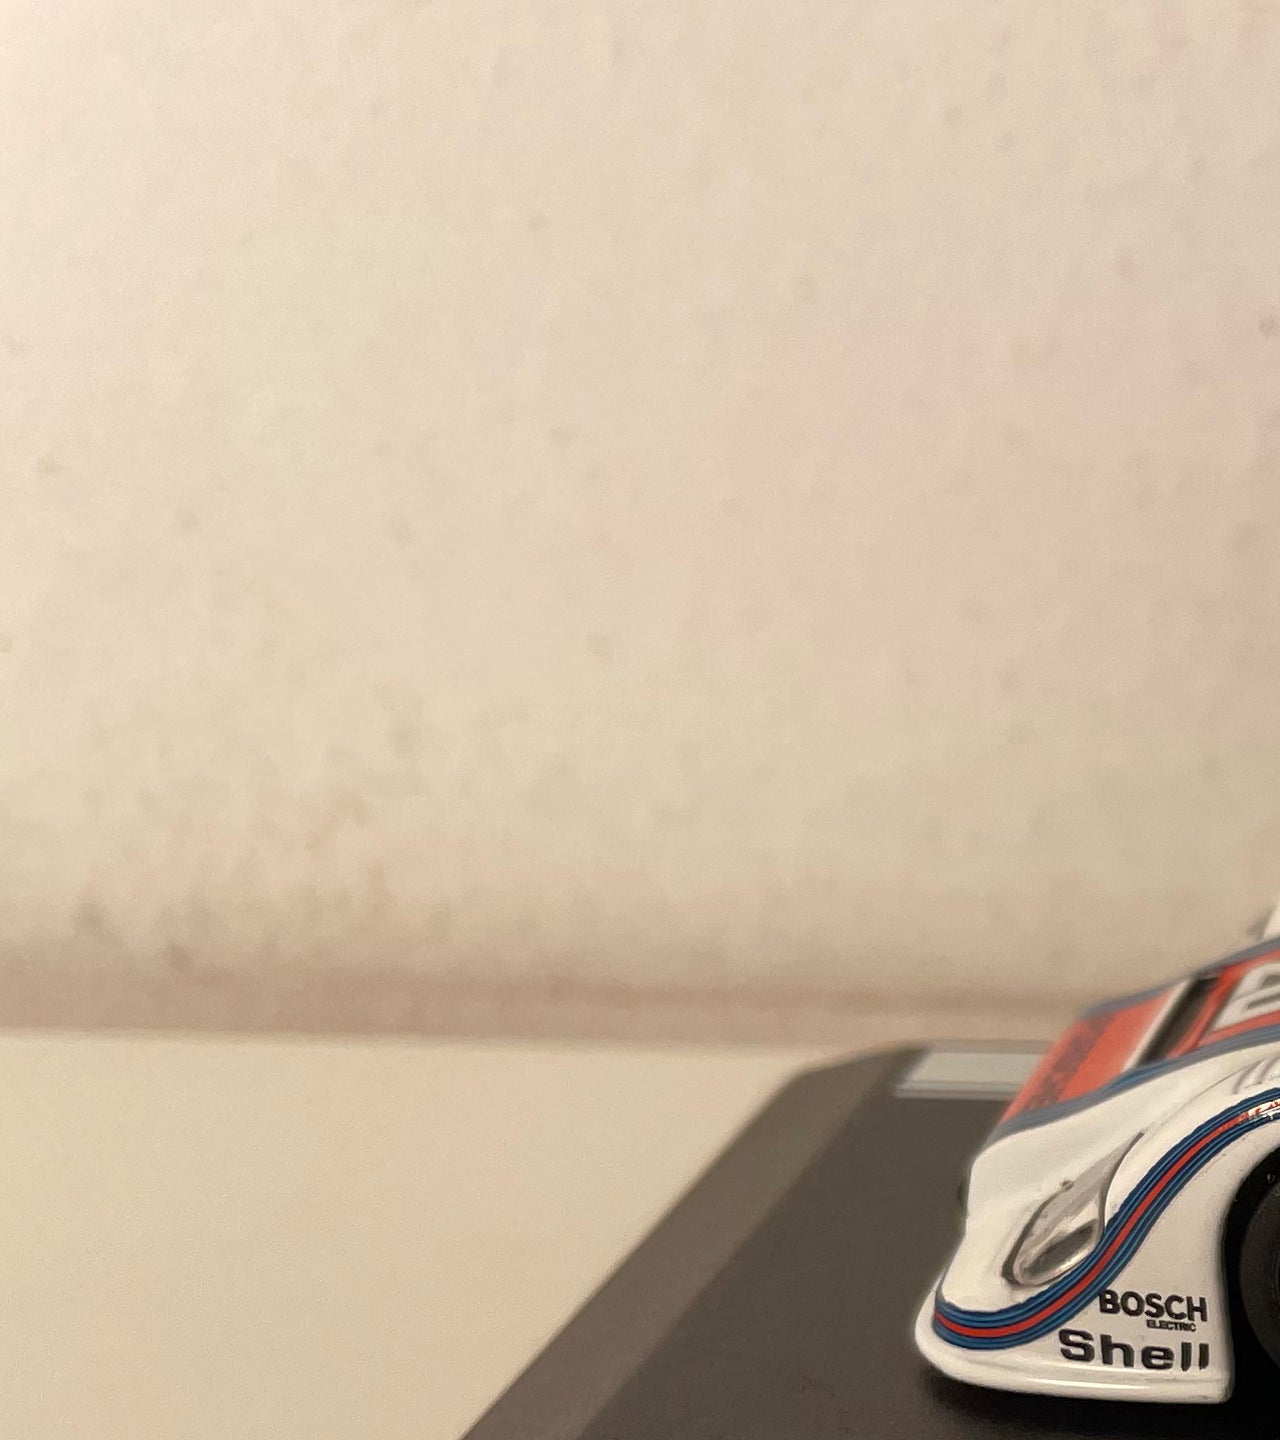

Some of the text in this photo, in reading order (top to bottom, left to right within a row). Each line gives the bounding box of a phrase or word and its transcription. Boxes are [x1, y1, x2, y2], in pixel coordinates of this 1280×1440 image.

[1099, 1288, 1208, 1323] BOSCH
[1146, 1318, 1197, 1333] ELECTRIC
[1058, 1328, 1210, 1372] Shell
